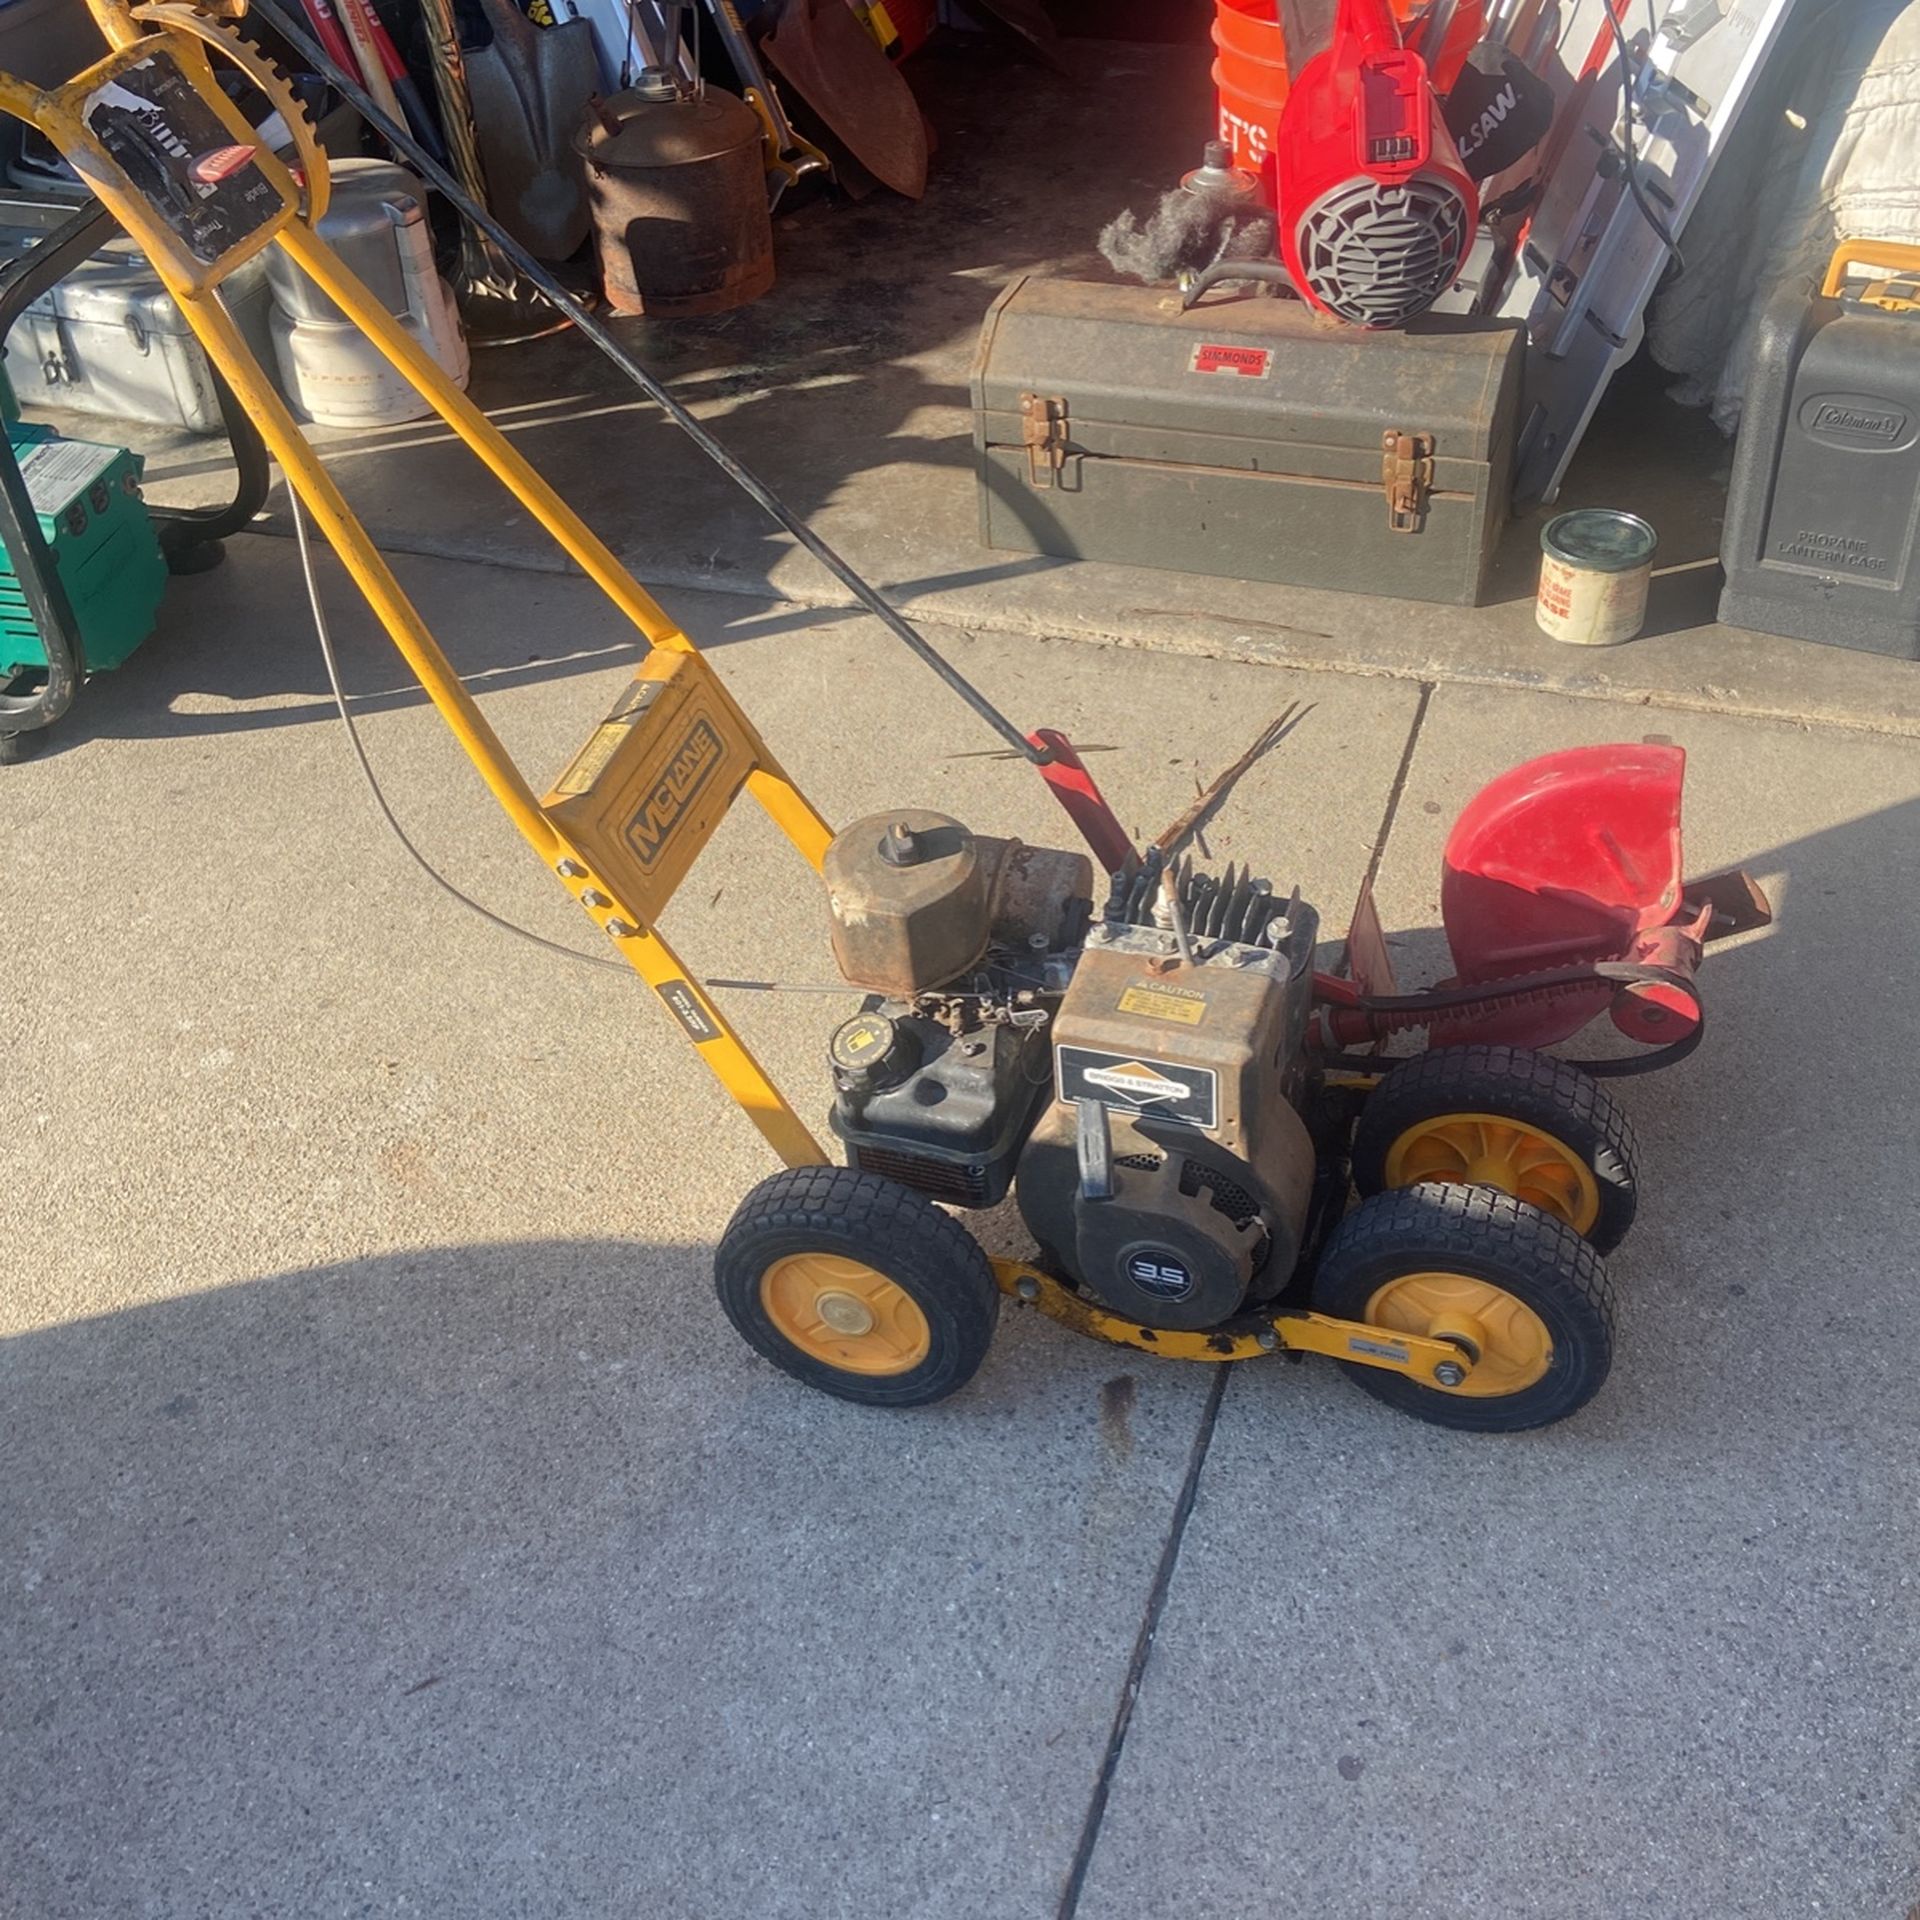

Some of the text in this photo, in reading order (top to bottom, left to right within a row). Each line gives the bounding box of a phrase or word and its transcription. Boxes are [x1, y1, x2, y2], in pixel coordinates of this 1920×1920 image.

[1459, 82, 1516, 159] LSAW
[1219, 105, 1268, 164] ET'S
[1202, 349, 1263, 366] SIMMONDS
[1824, 407, 1881, 431] Coleman
[1799, 530, 1869, 554] PROPANE
[1778, 541, 1888, 572] LANTERN CASE
[1149, 982, 1206, 999] CAUTION
[1088, 1072, 1125, 1084] BRIGGS
[1136, 1079, 1184, 1094] STRATTON
[1134, 1261, 1184, 1285] 3.5
